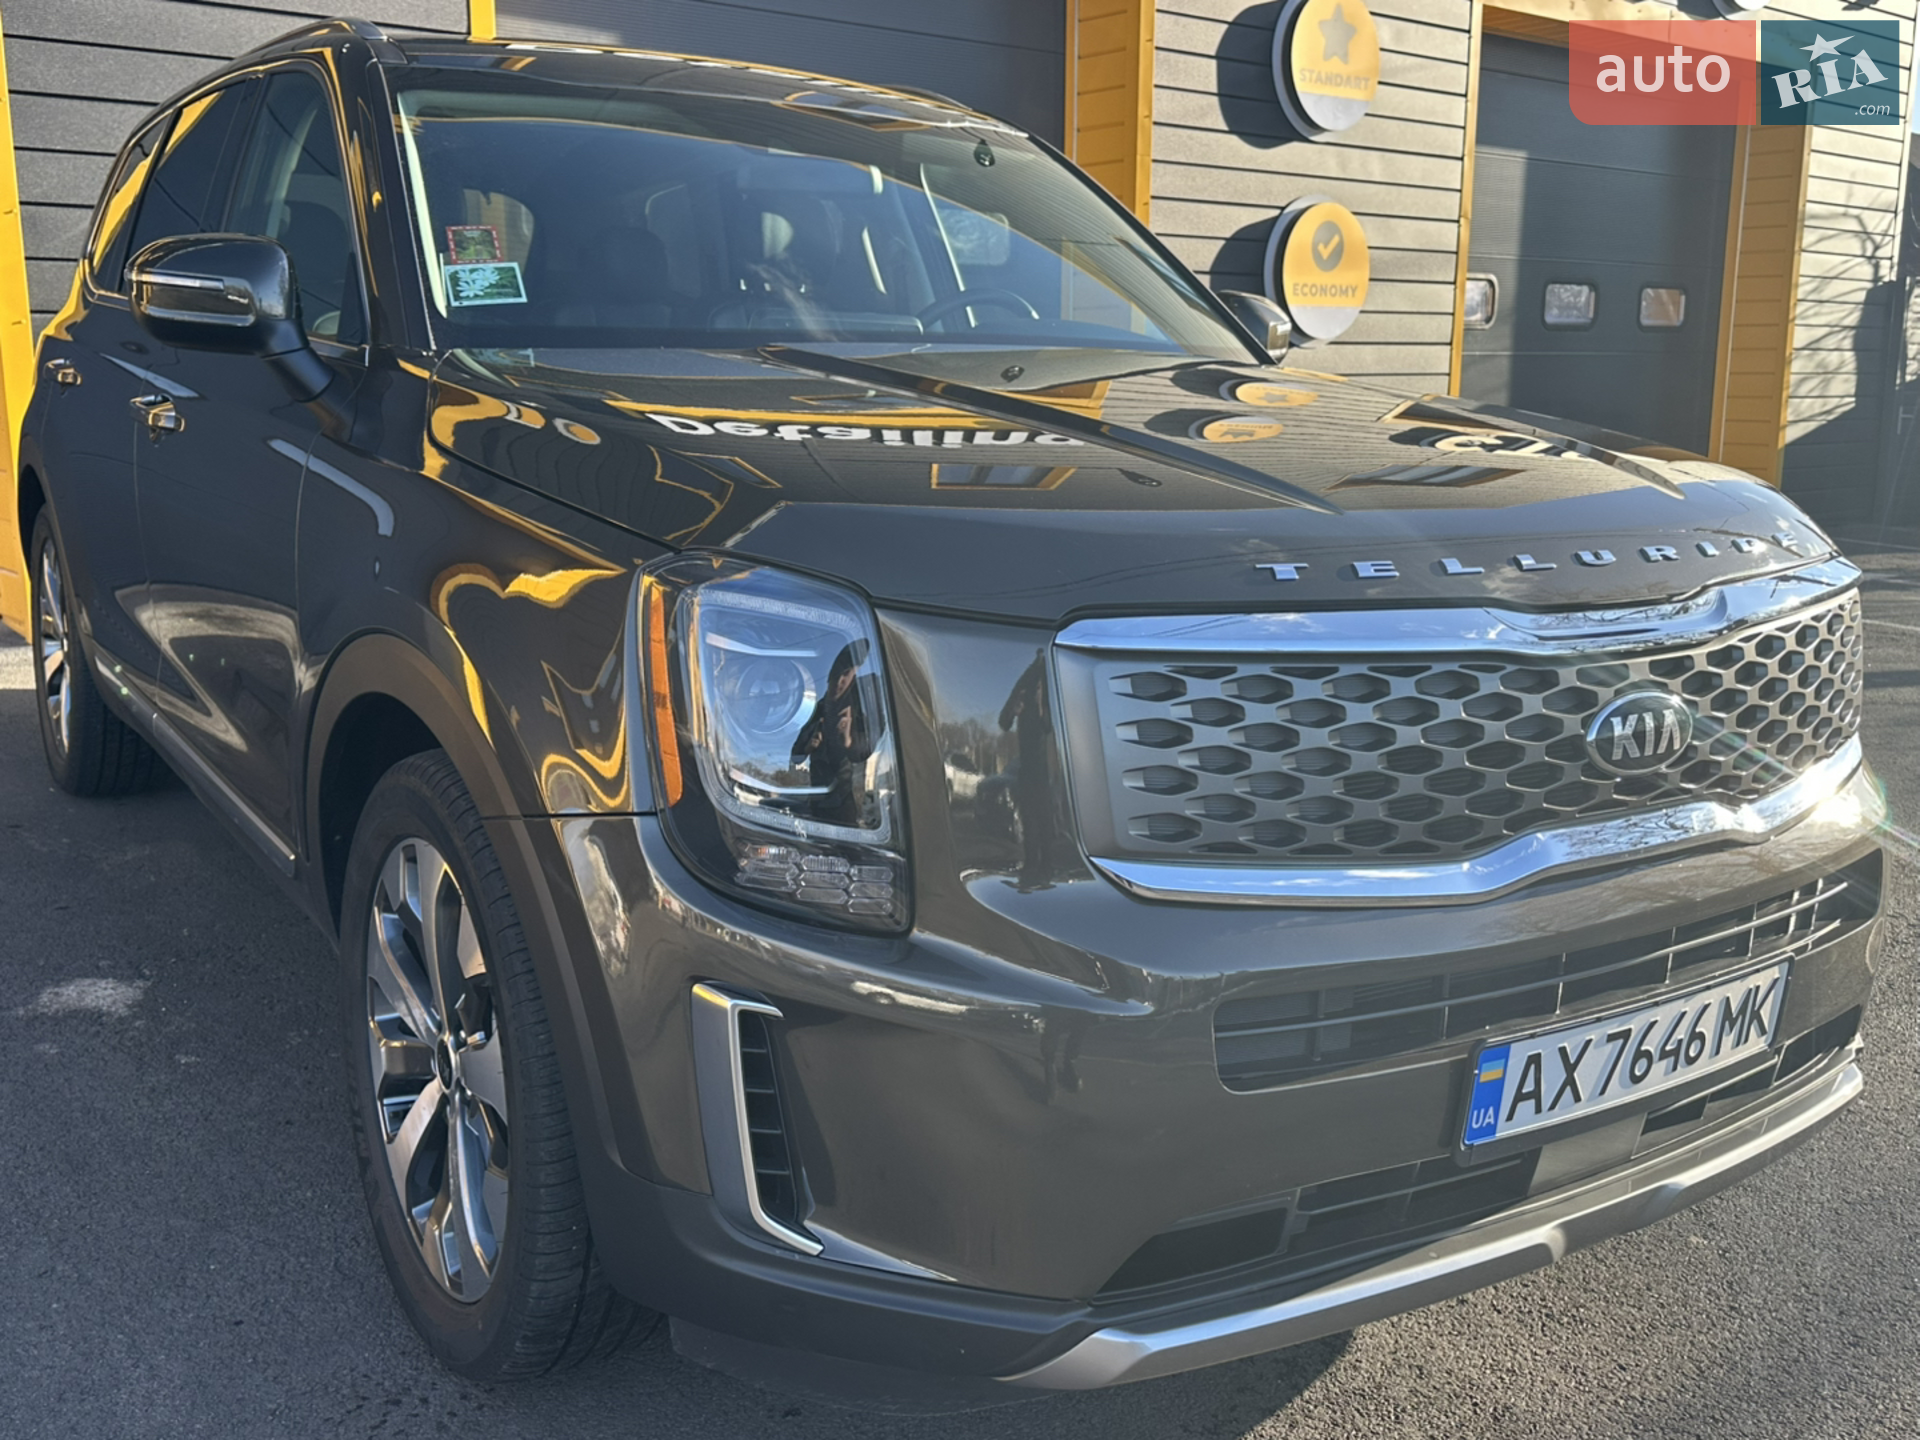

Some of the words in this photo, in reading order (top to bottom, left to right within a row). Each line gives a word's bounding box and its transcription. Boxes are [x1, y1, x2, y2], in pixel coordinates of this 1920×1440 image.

[1299, 68, 1371, 91] STANDART
[1292, 283, 1359, 298] ECONOMY
[1255, 531, 1799, 581] TELLURIDE
[1610, 708, 1681, 760] KIA
[1471, 1106, 1495, 1130] UA
